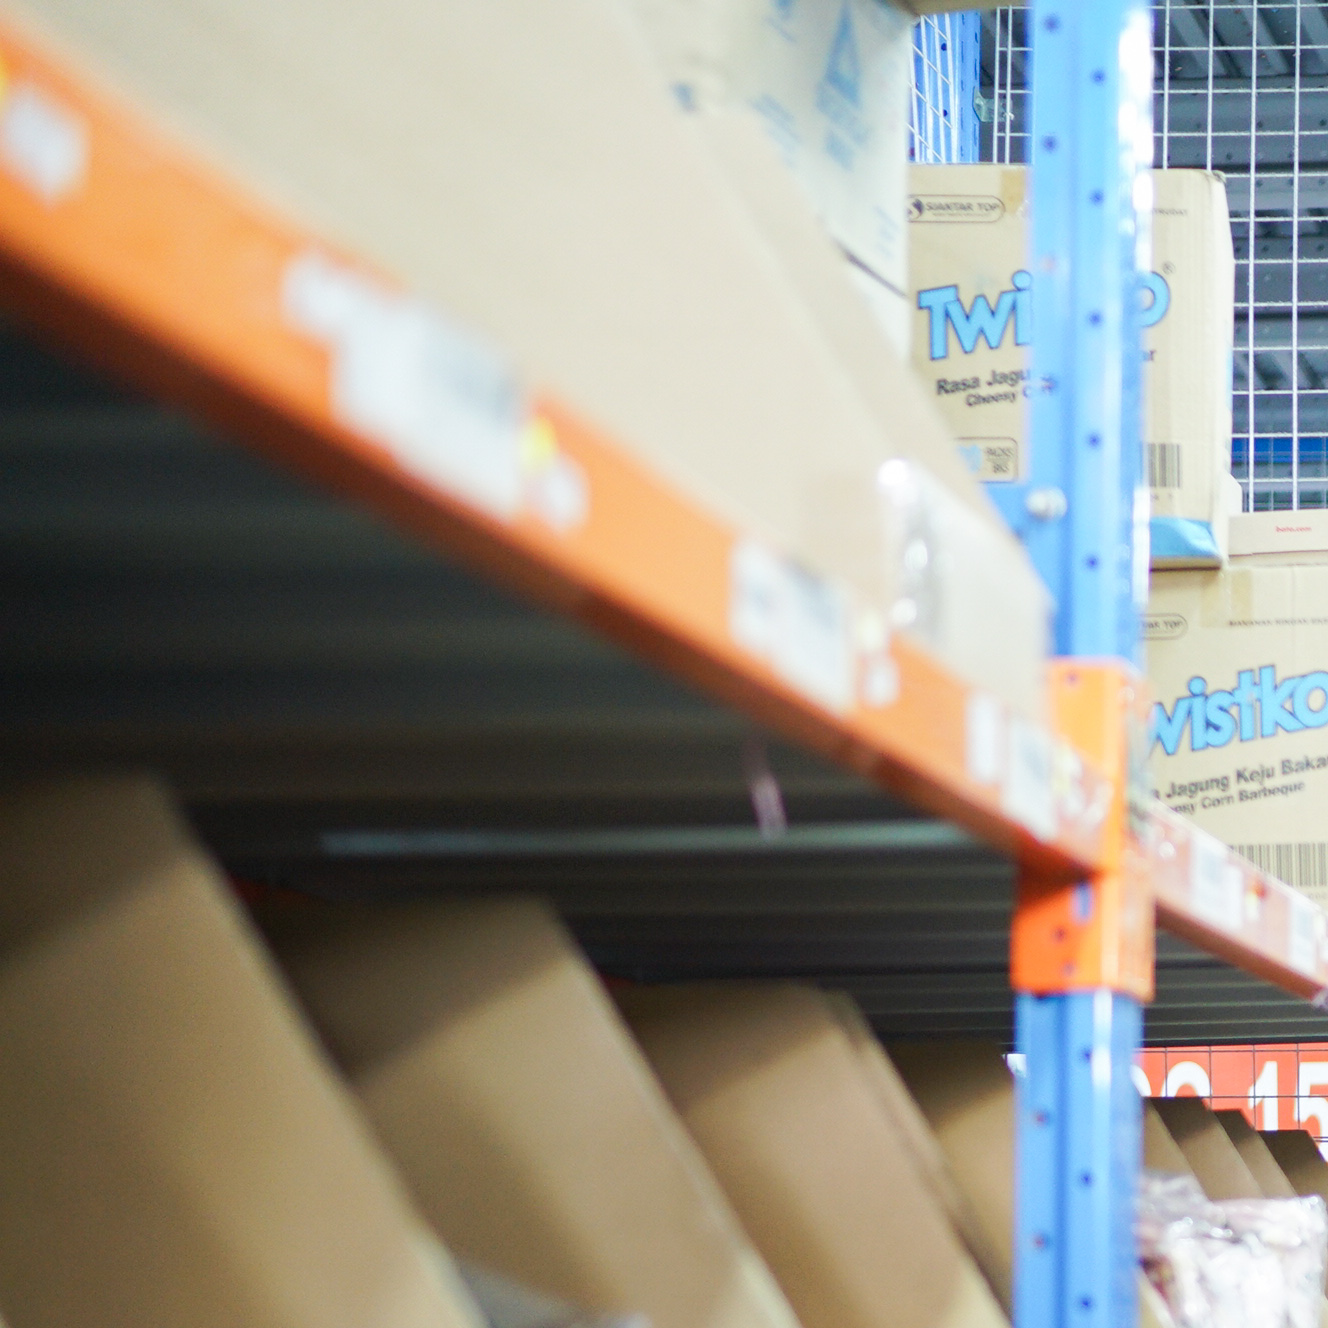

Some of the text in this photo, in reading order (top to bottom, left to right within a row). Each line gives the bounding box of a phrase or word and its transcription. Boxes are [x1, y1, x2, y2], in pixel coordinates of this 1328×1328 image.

[936, 376, 981, 396] Rasa
[1166, 774, 1230, 799] Jagung
[1236, 764, 1275, 785] Keju
